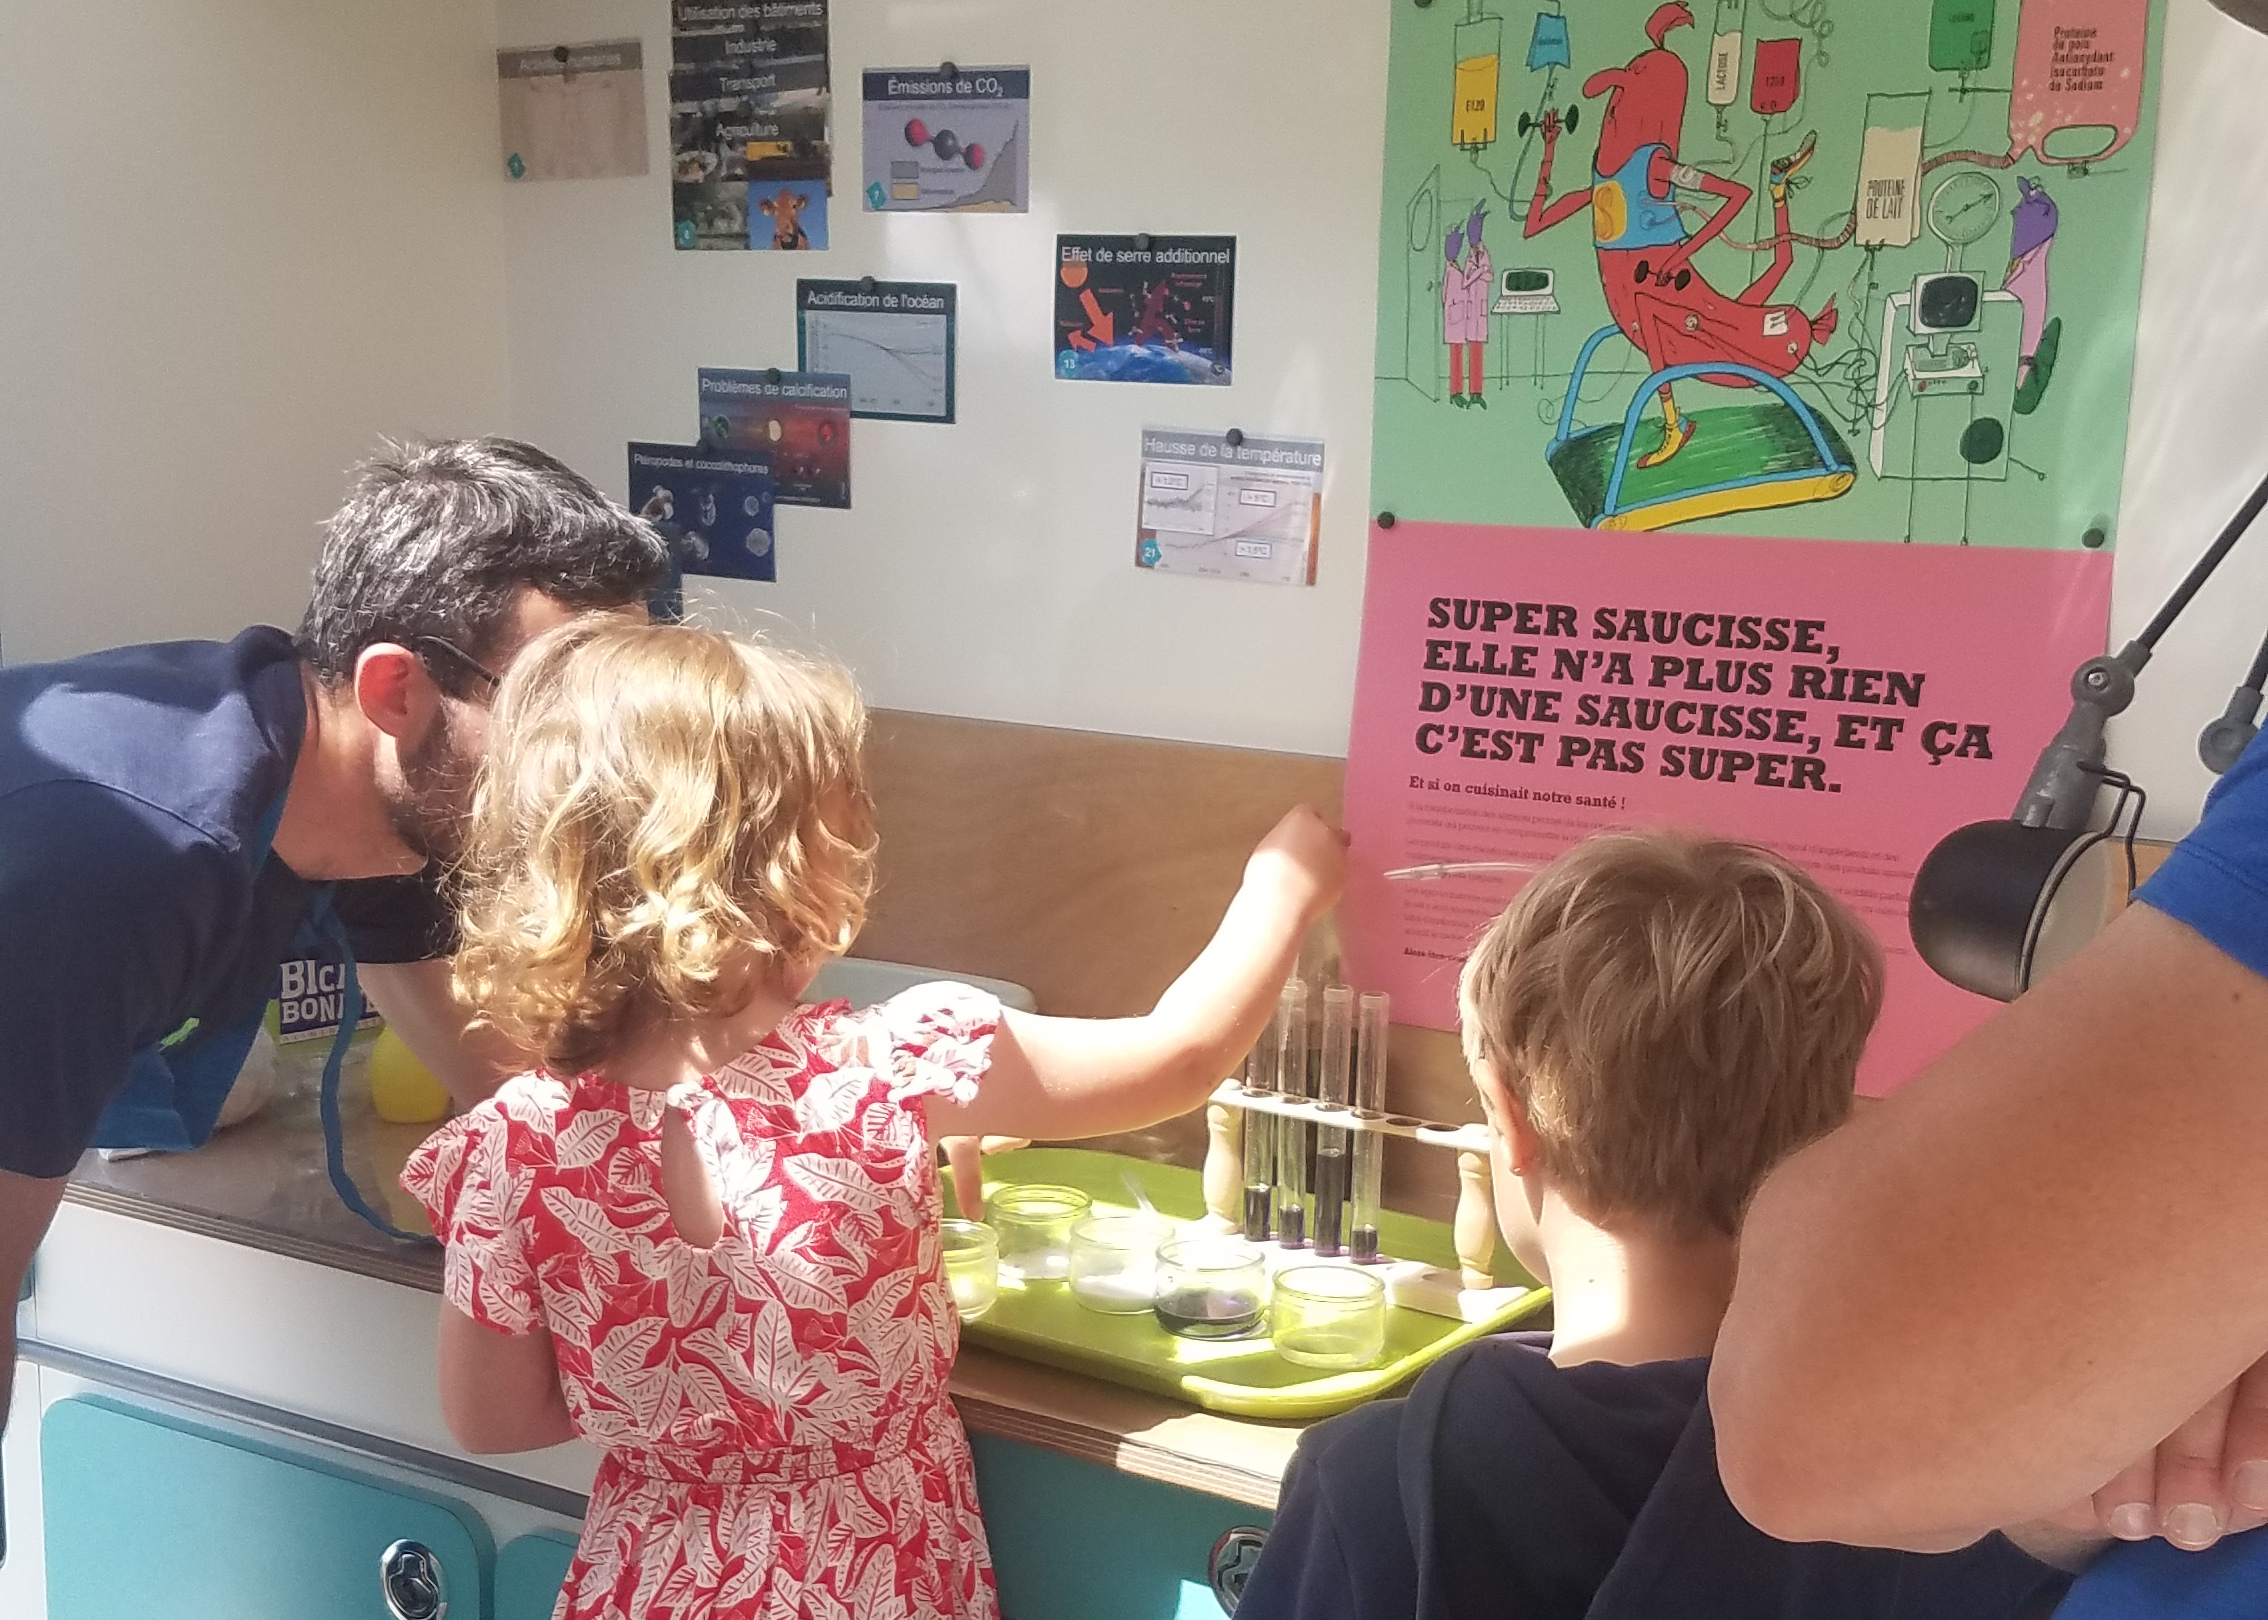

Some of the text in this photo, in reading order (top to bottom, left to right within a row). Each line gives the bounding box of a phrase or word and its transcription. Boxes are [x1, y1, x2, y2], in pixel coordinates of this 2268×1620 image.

[719, 74, 776, 92] Transport
[887, 76, 953, 96] Émissions
[955, 80, 973, 94] de
[1866, 197, 1903, 219] DE LAIT
[1061, 246, 1231, 264] Effet de serre additionnel
[807, 290, 880, 307] Acidification
[883, 294, 899, 308] de
[702, 378, 848, 399] Problèmes de calcification
[1144, 437, 1322, 466] Hausse de la température
[1427, 597, 1840, 663] SUPER SAUCISSE,
[1424, 639, 1925, 707] ELLE N'A PLUS RIEN
[1419, 681, 1993, 765] D'UNE SAUCISSE, ET ÇA
[1414, 723, 1842, 794] C'EST PAS SUPER.
[1409, 775, 1424, 789] Et
[1428, 777, 1440, 791] si
[1443, 782, 1461, 793] on
[1465, 783, 1530, 800] cuisinait
[1532, 789, 1572, 804] notre
[1575, 794, 1617, 809] santé
[281, 960, 346, 996] BIC
